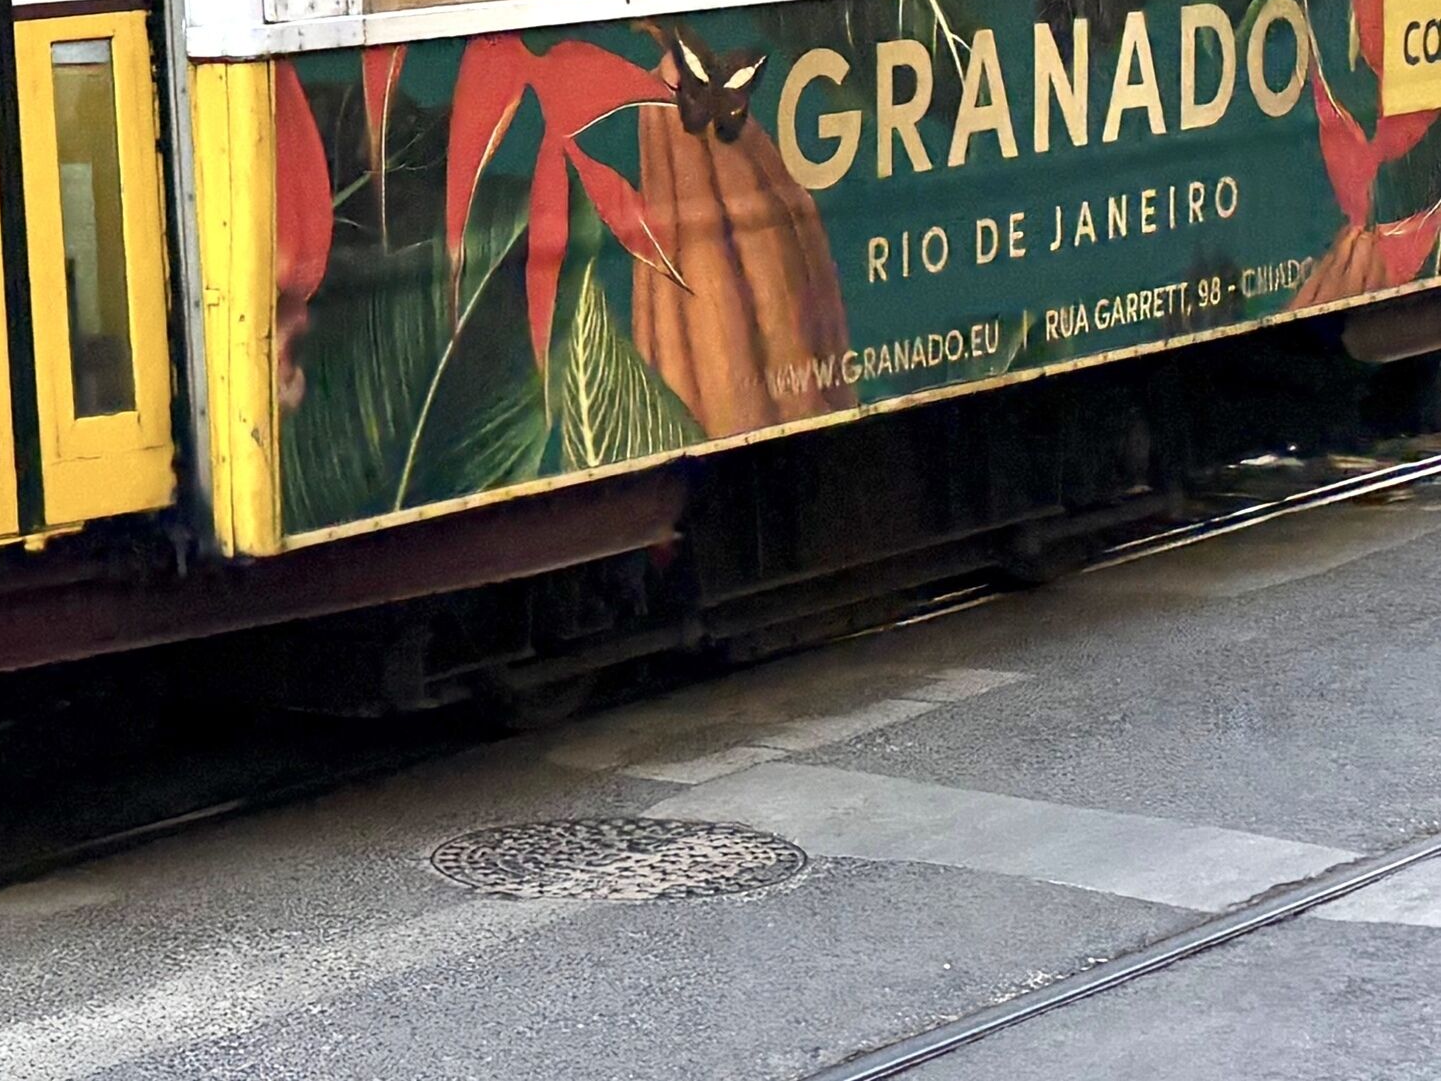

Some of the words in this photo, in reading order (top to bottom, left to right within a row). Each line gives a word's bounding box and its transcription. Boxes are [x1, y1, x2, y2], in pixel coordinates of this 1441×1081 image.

[868, 225, 949, 283] RIO
[976, 211, 1027, 265] DE
[1049, 175, 1239, 252] JANEIRO
[1046, 304, 1090, 341] RUA
[1094, 281, 1192, 329] GARRETT,
[1197, 276, 1221, 308] 98
